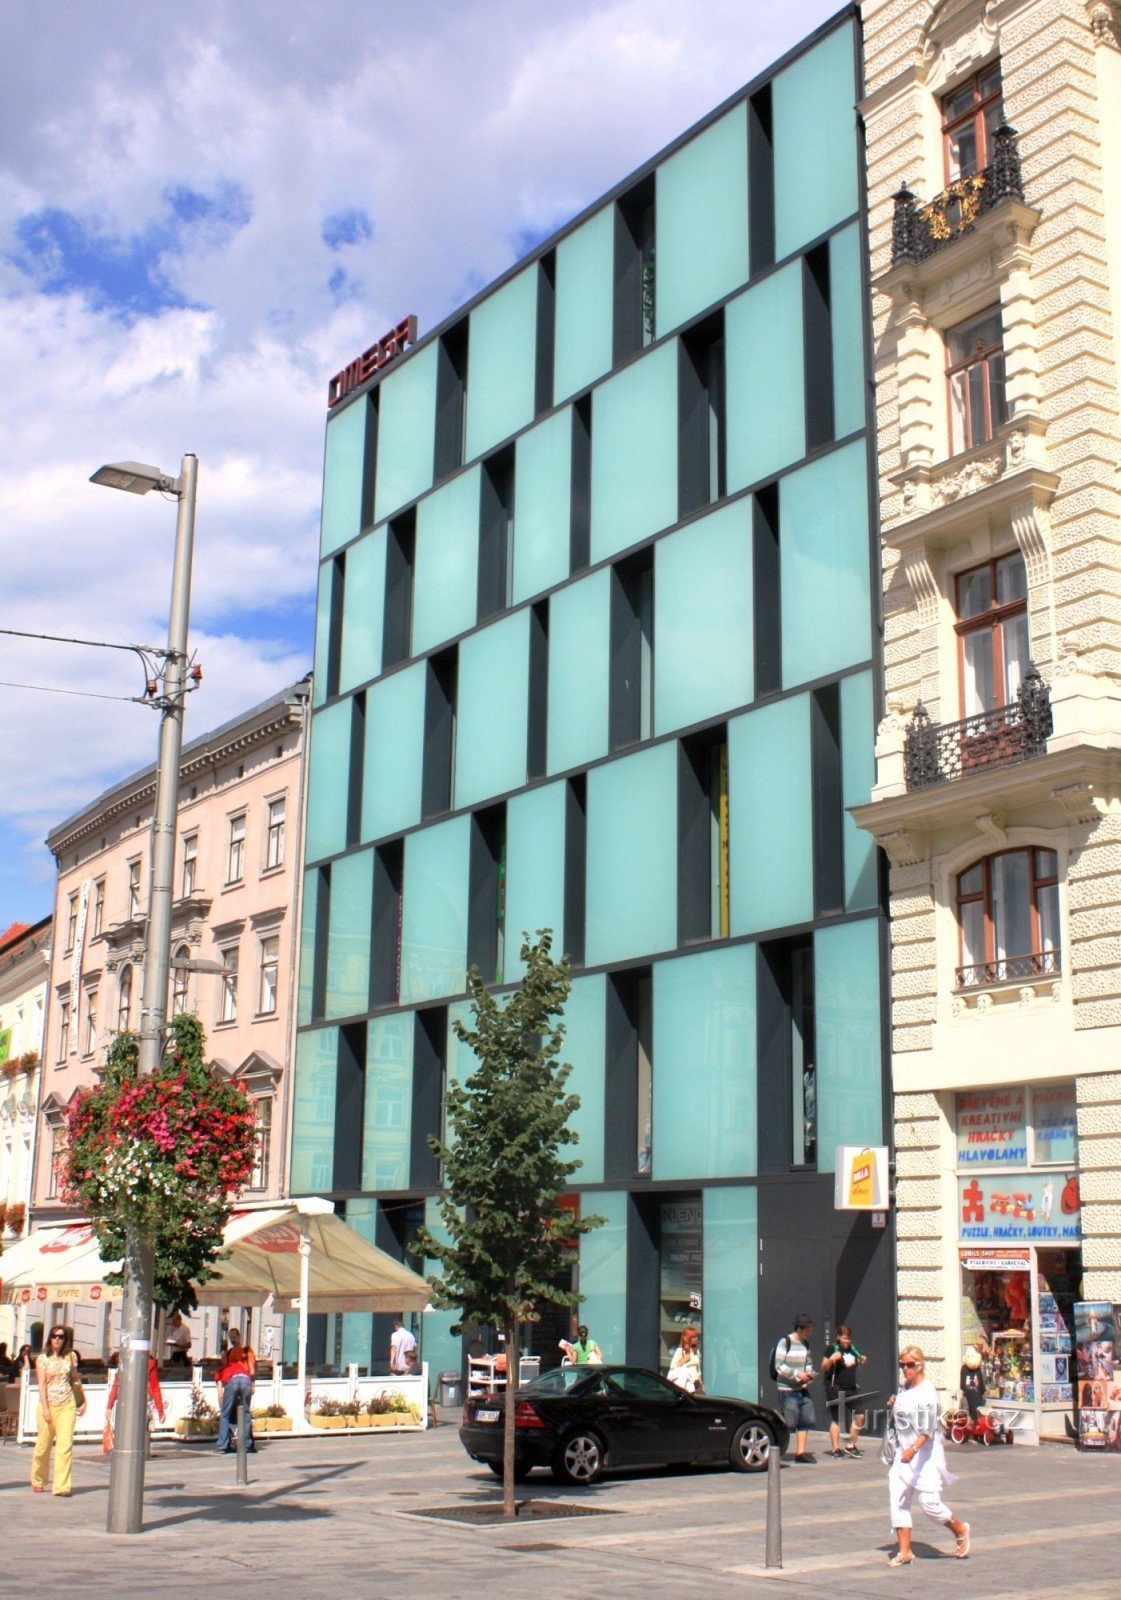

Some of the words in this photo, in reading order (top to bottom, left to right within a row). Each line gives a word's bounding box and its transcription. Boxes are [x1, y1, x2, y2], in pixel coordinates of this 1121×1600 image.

[328, 314, 418, 408] OMEGA
[968, 1125, 1015, 1143] HRAČKY
[1036, 1129, 1078, 1141] KARNEV
[958, 1146, 1027, 1162] HLAVOLAMY
